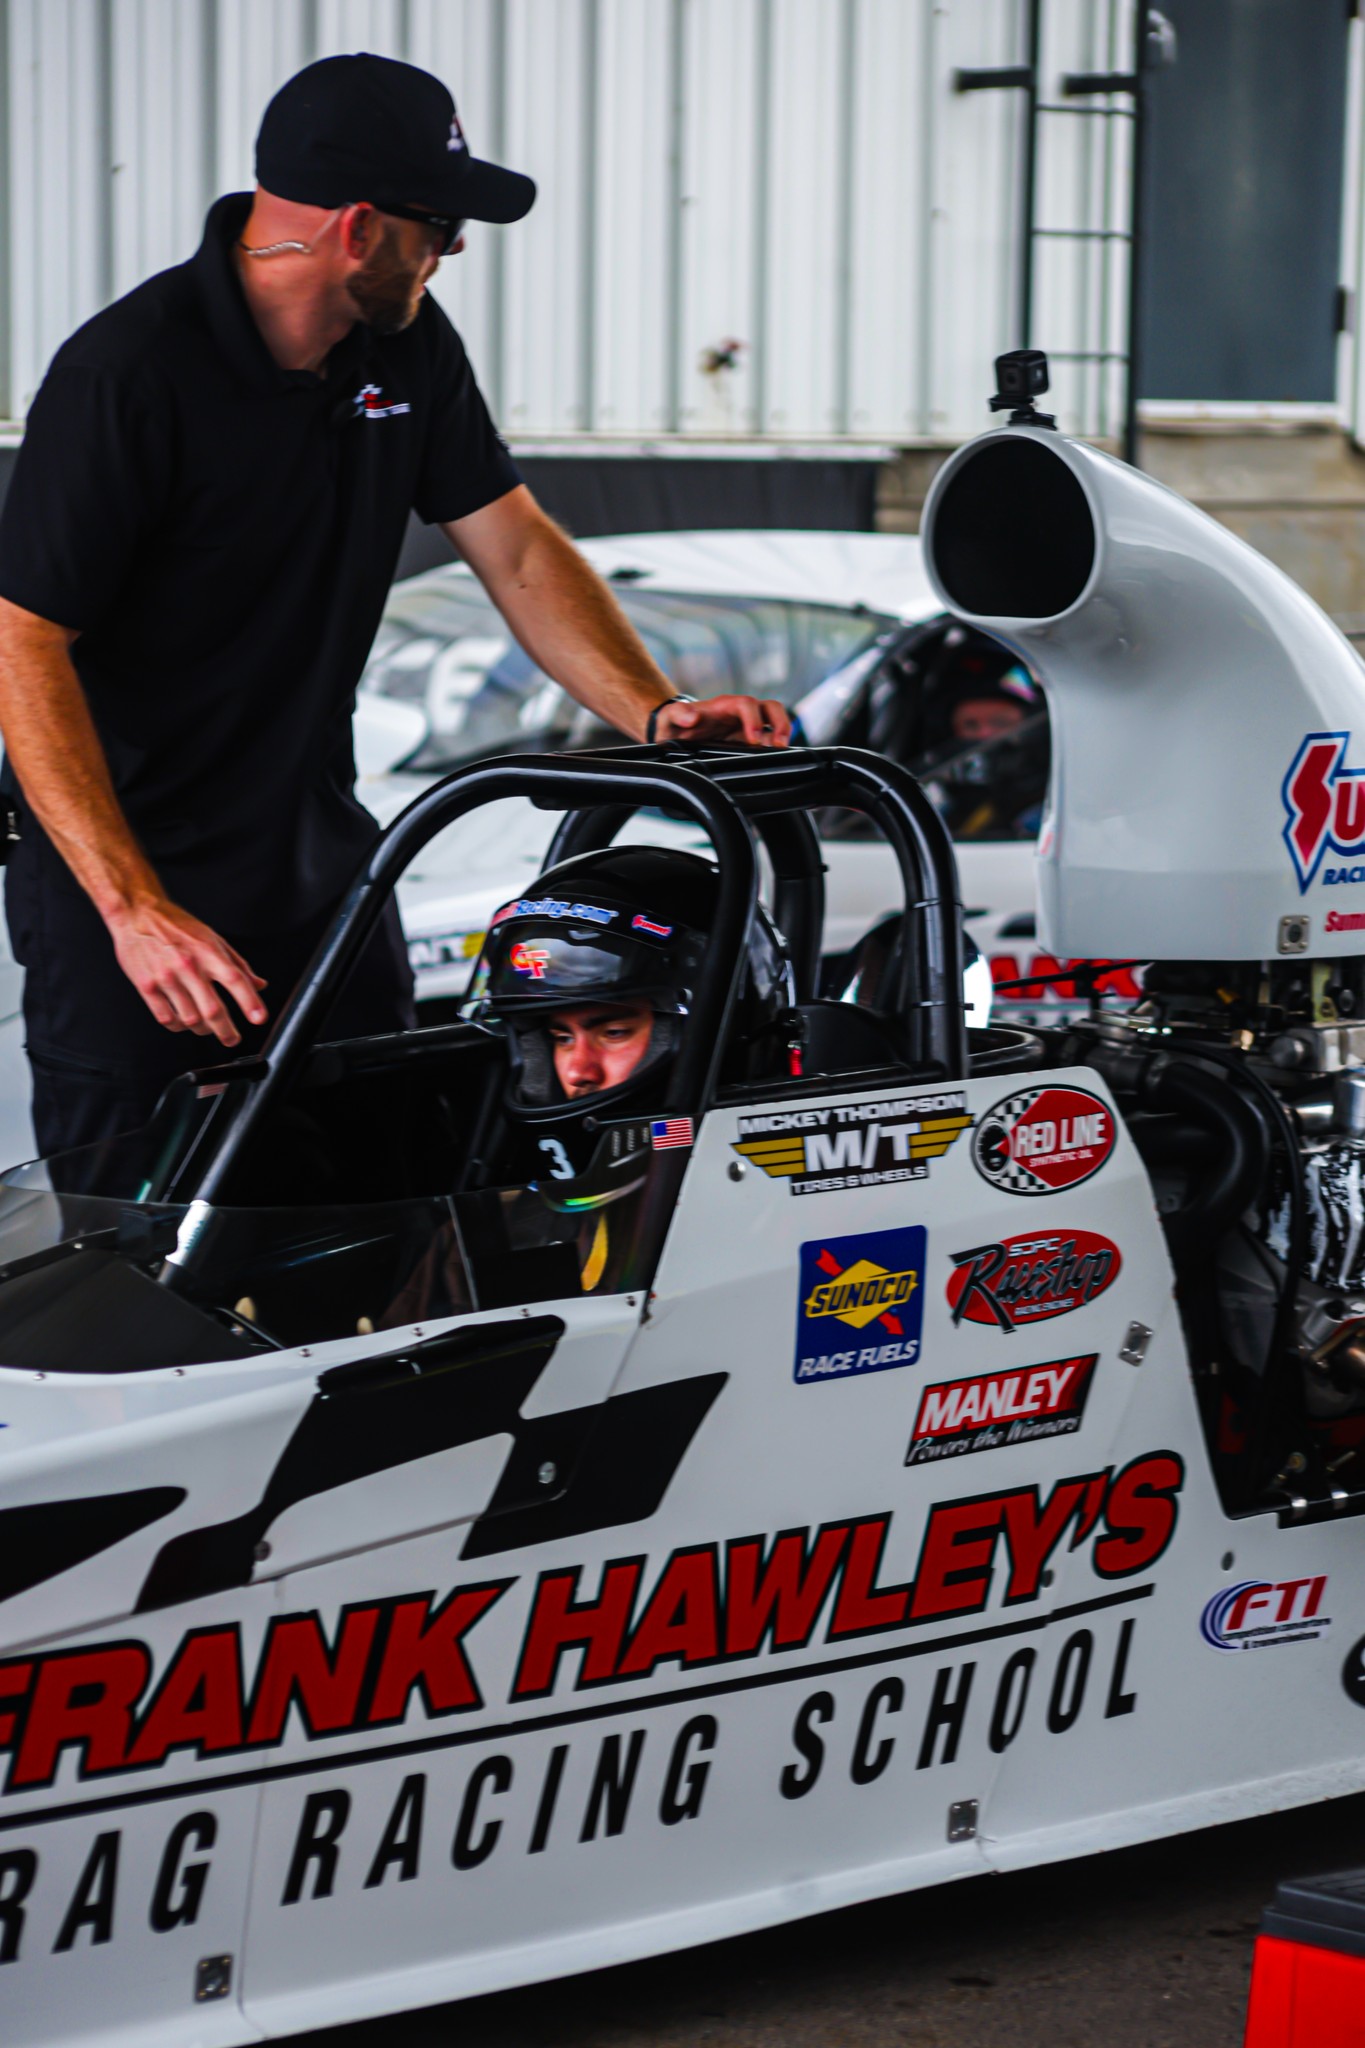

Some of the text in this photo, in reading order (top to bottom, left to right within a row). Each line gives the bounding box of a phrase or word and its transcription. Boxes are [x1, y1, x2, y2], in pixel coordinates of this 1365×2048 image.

[739, 1094, 965, 1134] MICKEY THOMPSON
[1013, 1112, 1107, 1158] RED LINE
[538, 1137, 576, 1181] 3
[806, 1122, 921, 1172] M/T
[791, 1176, 847, 1194] TIRES
[859, 1166, 927, 1185] WHEELS
[810, 1273, 909, 1315] SUNOCO
[797, 1339, 919, 1378] RACE FUELS
[918, 1366, 1076, 1434] MANLEY
[907, 1416, 1079, 1463] Powers the Winners
[508, 1448, 1185, 1704] HAWLEY'S
[1225, 1574, 1329, 1631] FTI
[281, 1714, 719, 1907] RACING
[779, 1617, 1138, 1801] SCHOOL
